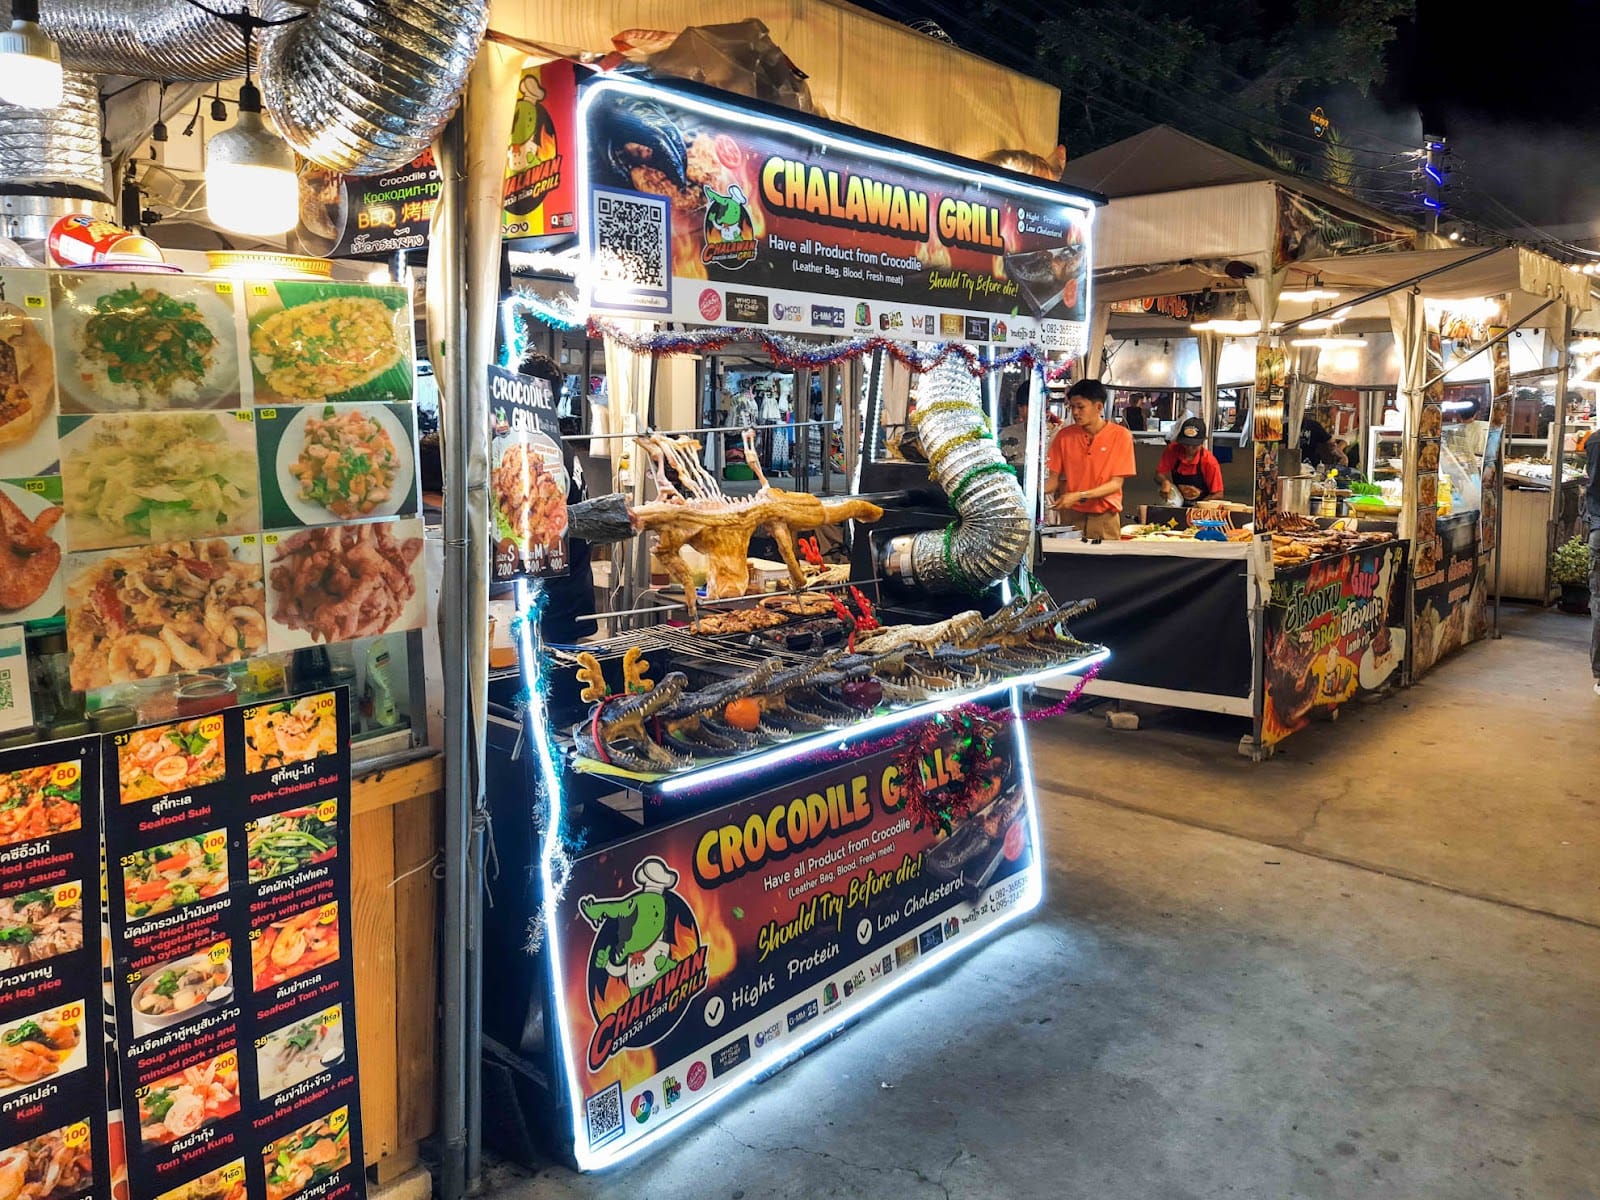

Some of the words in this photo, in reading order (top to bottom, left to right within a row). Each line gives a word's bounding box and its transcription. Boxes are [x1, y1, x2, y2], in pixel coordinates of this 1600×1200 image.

[380, 171, 427, 187] Crocodile
[532, 174, 560, 198] GRILL
[761, 156, 928, 237] CHALAWAN
[937, 197, 1004, 249] GRILL
[357, 207, 396, 228] BBQ
[1026, 224, 1035, 233] Low
[768, 234, 796, 252] Have
[799, 238, 812, 253] all
[814, 243, 853, 261] Product
[856, 250, 878, 265] from
[880, 255, 922, 271] Crocodile
[792, 262, 824, 276] (Leather
[825, 265, 841, 279] Bag,
[843, 268, 865, 281] Blood,
[866, 271, 884, 282] Fresh
[885, 274, 904, 286] meat)
[929, 271, 960, 291] Should
[961, 273, 975, 301] Try
[976, 275, 1001, 297] Before
[1002, 279, 1019, 297] die!
[492, 376, 552, 410] CROCODILE
[512, 406, 543, 434] GRILL
[507, 544, 515, 562] S
[534, 543, 543, 560] M
[558, 540, 564, 556] L
[242, 708, 257, 720] 32
[315, 698, 333, 710] 100
[201, 721, 221, 733] 120
[113, 734, 129, 746] 31
[56, 767, 77, 781] 80
[250, 780, 317, 804] Pork-Chicken
[319, 774, 339, 786] Suki
[139, 812, 186, 831] Seafood
[187, 804, 211, 819] Suki
[317, 804, 335, 817] 100
[243, 821, 257, 832] 34
[695, 775, 871, 881] CROCODILE
[203, 836, 225, 849] 100
[25, 851, 74, 870] chicken
[120, 854, 136, 867] 33
[763, 872, 791, 892] Have
[793, 861, 806, 878] all
[808, 846, 846, 873] Product
[848, 837, 870, 856] from
[871, 817, 912, 844] Crocodile
[3, 878, 26, 891] soy
[29, 868, 67, 885] sauce
[788, 879, 818, 900] (Leather
[819, 871, 836, 886] Bag,
[837, 860, 858, 878] Blood,
[859, 852, 877, 866] Fresh
[877, 843, 896, 860] meat)
[57, 887, 78, 902] 80
[249, 890, 295, 912] Stir-fried
[295, 878, 335, 898] morning
[877, 911, 900, 932] Low
[903, 870, 965, 918] Cholesterol
[251, 911, 277, 928] glory
[278, 903, 299, 916] with
[300, 896, 317, 908] red
[317, 891, 334, 902] fire
[319, 907, 337, 921] 200
[758, 904, 816, 964] Should
[819, 893, 845, 932] Try
[846, 868, 892, 909] Before
[895, 852, 924, 885] die!
[133, 924, 186, 948] Stir-fried
[186, 912, 220, 931] mixed
[150, 927, 211, 952] vegetables
[248, 928, 262, 940] 36
[131, 954, 156, 969] with
[157, 942, 194, 961] oyster
[194, 931, 227, 949] sauce
[127, 970, 142, 984] 35
[731, 973, 776, 1012] Hight
[787, 942, 840, 982] Protein
[15, 986, 36, 999] leg
[38, 978, 62, 992] rice
[667, 969, 708, 1013] GRILL
[256, 997, 296, 1020] Seafood
[297, 989, 318, 1002] Tom
[319, 980, 340, 994] Yum
[590, 947, 706, 1066] CHALAWAN
[807, 1003, 818, 1018] 25
[61, 1006, 81, 1022] 80
[137, 1051, 167, 1069] Soup
[168, 1040, 192, 1057] with
[194, 1031, 215, 1047] tofu
[216, 1023, 237, 1038] and
[254, 1035, 268, 1048] 38
[140, 1060, 181, 1082] minced
[181, 1050, 206, 1068] pork
[216, 1038, 237, 1052] rice
[214, 1057, 236, 1072] 200
[135, 1086, 150, 1098] 37
[252, 1115, 275, 1128] Tom
[275, 1105, 293, 1119] kha
[293, 1087, 329, 1108] chicken
[337, 1074, 354, 1088] rice
[16, 1102, 44, 1120] Kaki
[64, 1126, 87, 1143] 100
[156, 1157, 181, 1174] Tom
[182, 1145, 207, 1162] Yum
[207, 1132, 236, 1151] Kung
[261, 1142, 274, 1155] 40
